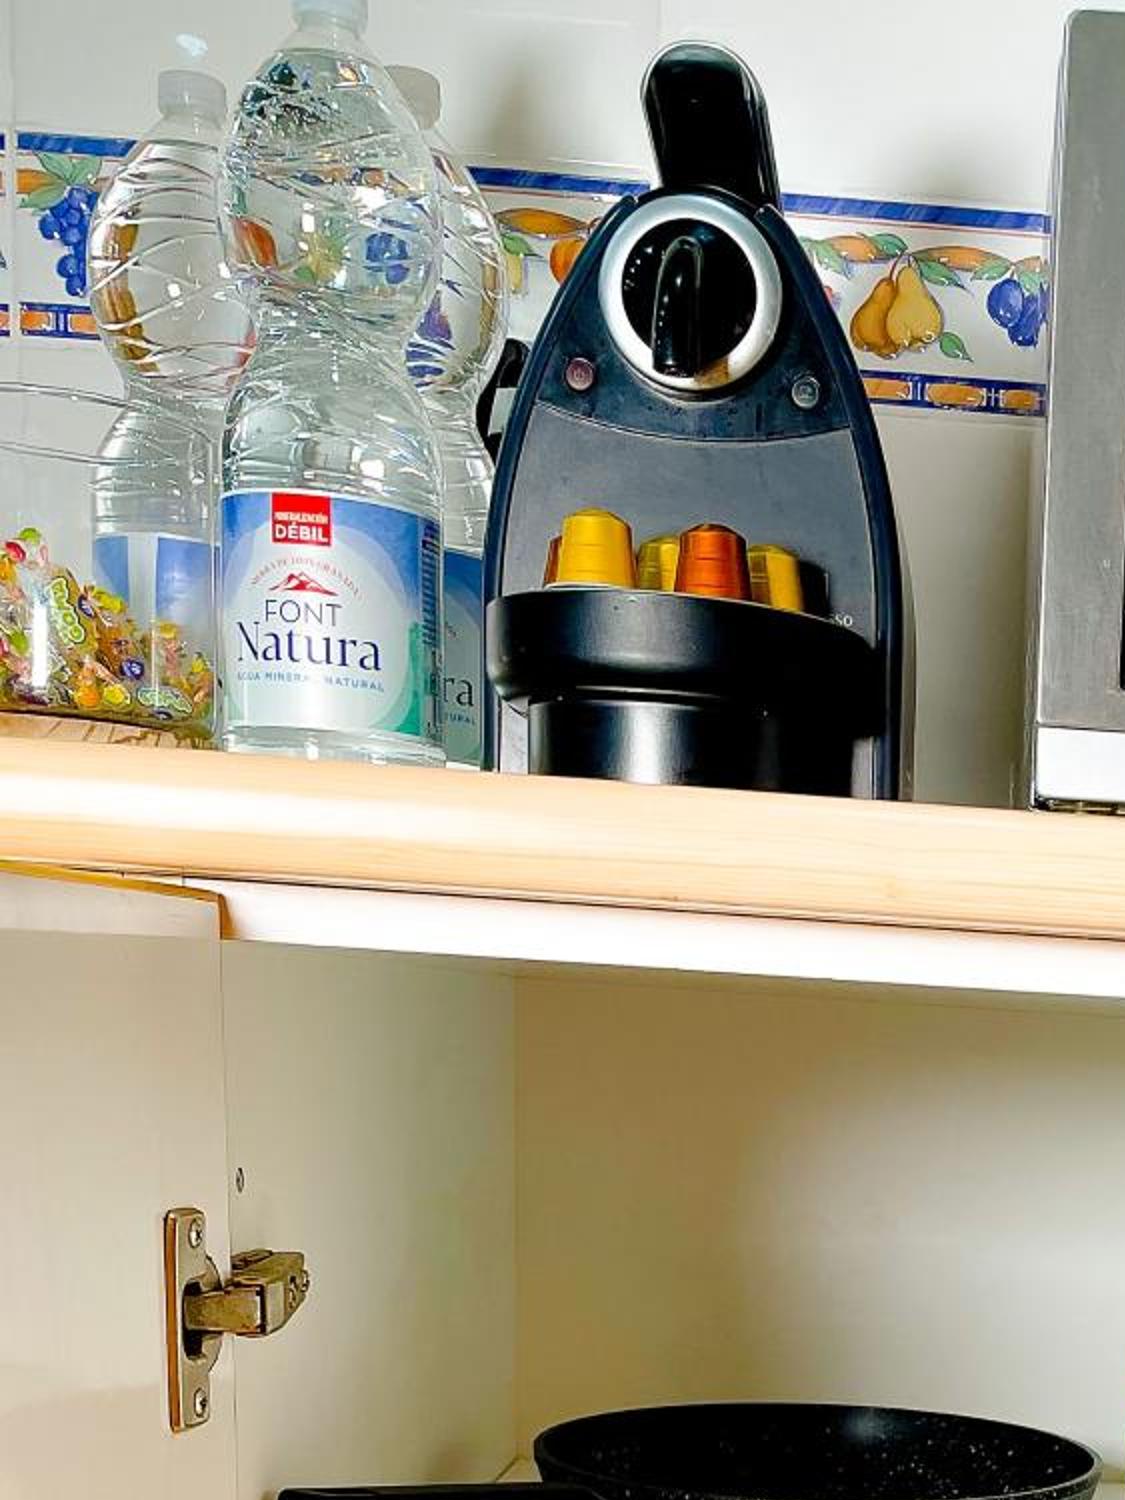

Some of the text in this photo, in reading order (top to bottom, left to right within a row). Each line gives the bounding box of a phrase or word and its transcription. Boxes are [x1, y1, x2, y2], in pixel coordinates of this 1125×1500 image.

[275, 522, 329, 543] DÉBIL
[264, 599, 342, 627] FONT
[237, 620, 382, 672] Natura
[324, 676, 385, 693] NATURAL
